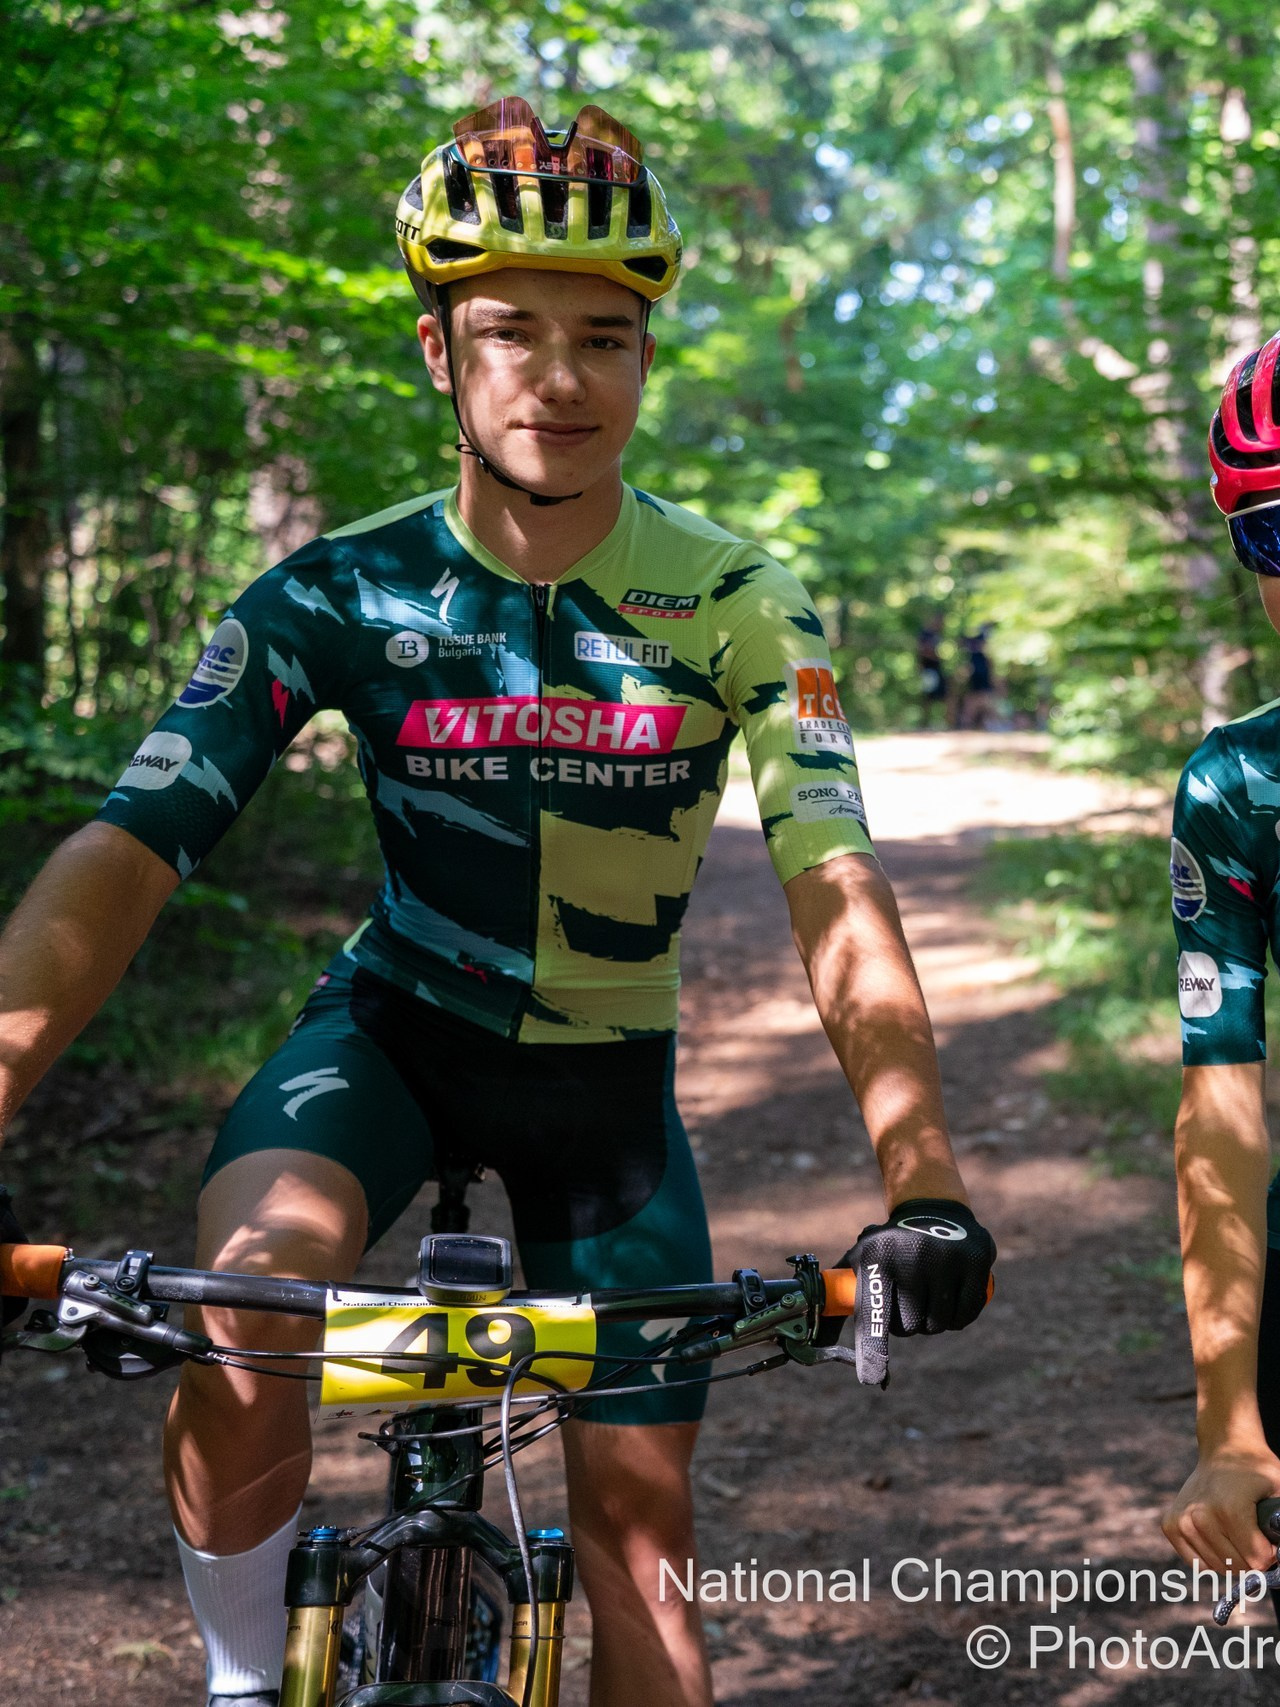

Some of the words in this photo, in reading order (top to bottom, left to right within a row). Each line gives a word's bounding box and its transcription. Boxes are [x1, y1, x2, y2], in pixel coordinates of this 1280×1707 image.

[626, 591, 697, 609] DIEM
[625, 607, 690, 618] SPORT
[438, 634, 476, 647] TISSUE
[477, 631, 507, 645] BANK
[438, 645, 482, 660] Bulgaria
[425, 703, 661, 750] VITOSHA
[798, 720, 833, 731] TRADE
[405, 755, 509, 781] BIKE
[529, 757, 691, 788] CENTER
[797, 787, 839, 801] SONO
[867, 1263, 884, 1338] ERGON
[381, 1312, 536, 1389] 49
